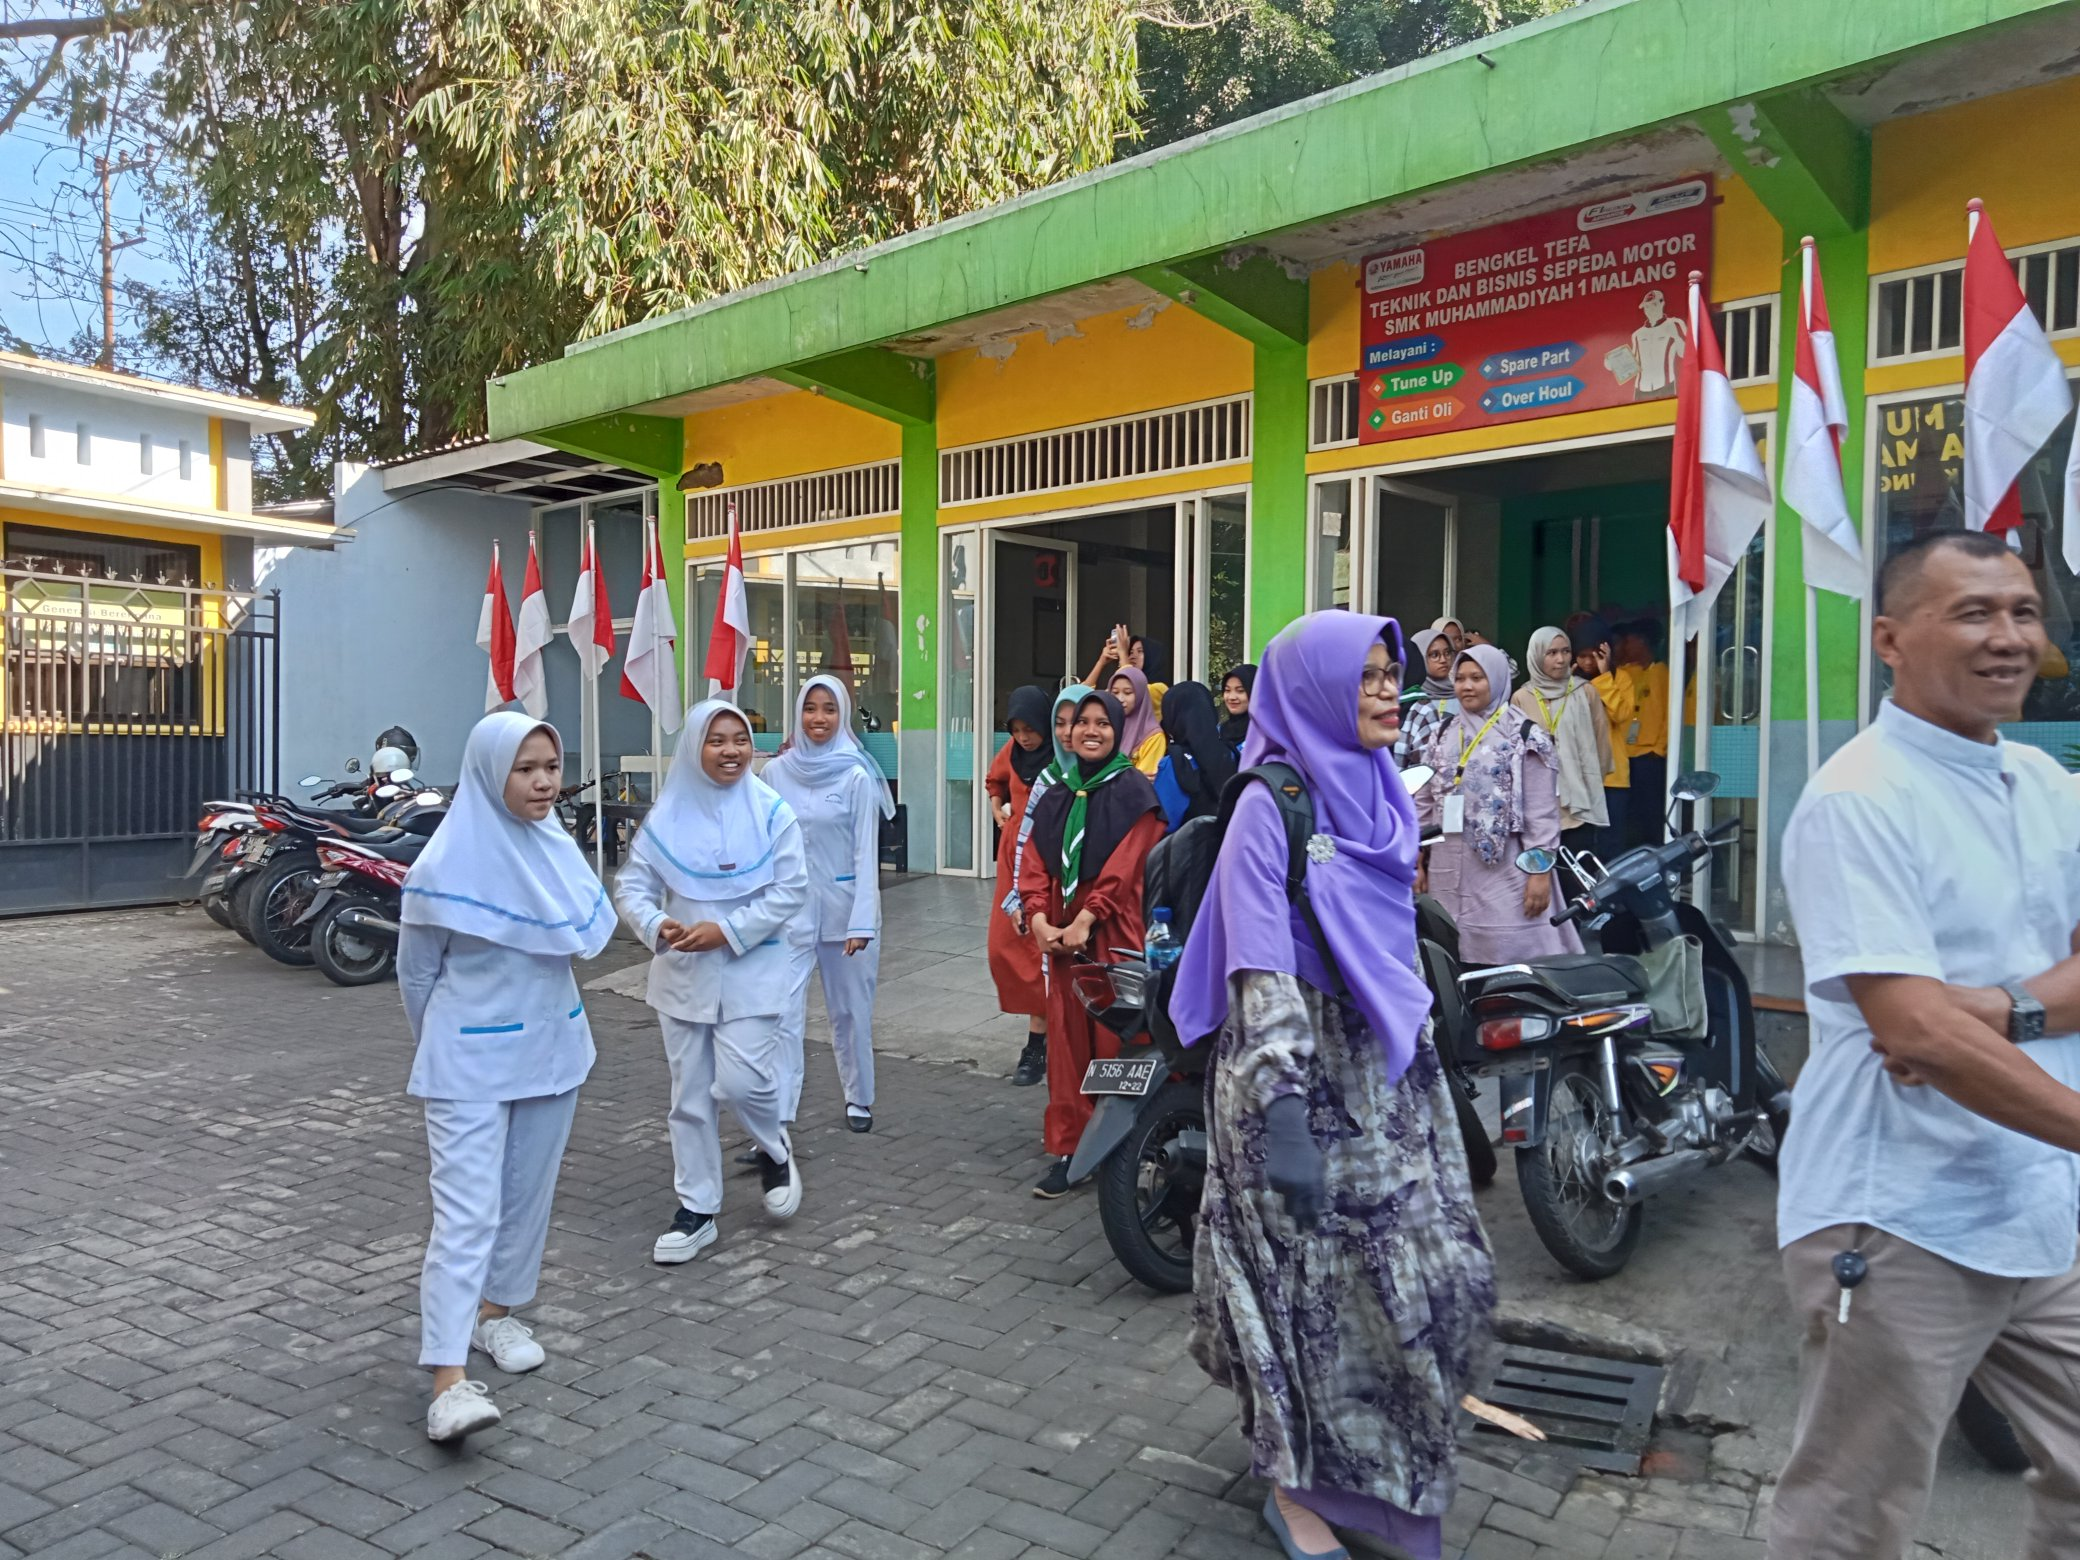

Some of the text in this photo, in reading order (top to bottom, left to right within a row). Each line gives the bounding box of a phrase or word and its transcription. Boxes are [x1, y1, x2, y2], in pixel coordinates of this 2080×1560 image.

[1380, 253, 1422, 272] YAMAHA
[1455, 234, 1591, 280] BENGKEL TEFA
[1369, 290, 1431, 319] TEKNIK
[1436, 282, 1471, 304] DAN
[1476, 268, 1536, 296] BISNIS
[1543, 250, 1617, 282] SEPEDA
[1623, 233, 1696, 265] MOTOR
[1385, 314, 1421, 336] SMK
[1425, 282, 1574, 329] MUHAMMADIYAH
[1577, 279, 1586, 296] 1
[1591, 261, 1677, 294] MALANG
[1369, 342, 1427, 364] Melayani
[1500, 348, 1570, 376] Spare Part
[1391, 369, 1454, 391] Tune Up
[1502, 381, 1572, 407] Over Houl
[1391, 402, 1452, 424] Ganti Oli
[1099, 1064, 1124, 1078] 5156
[1127, 1064, 1152, 1079] AAE
